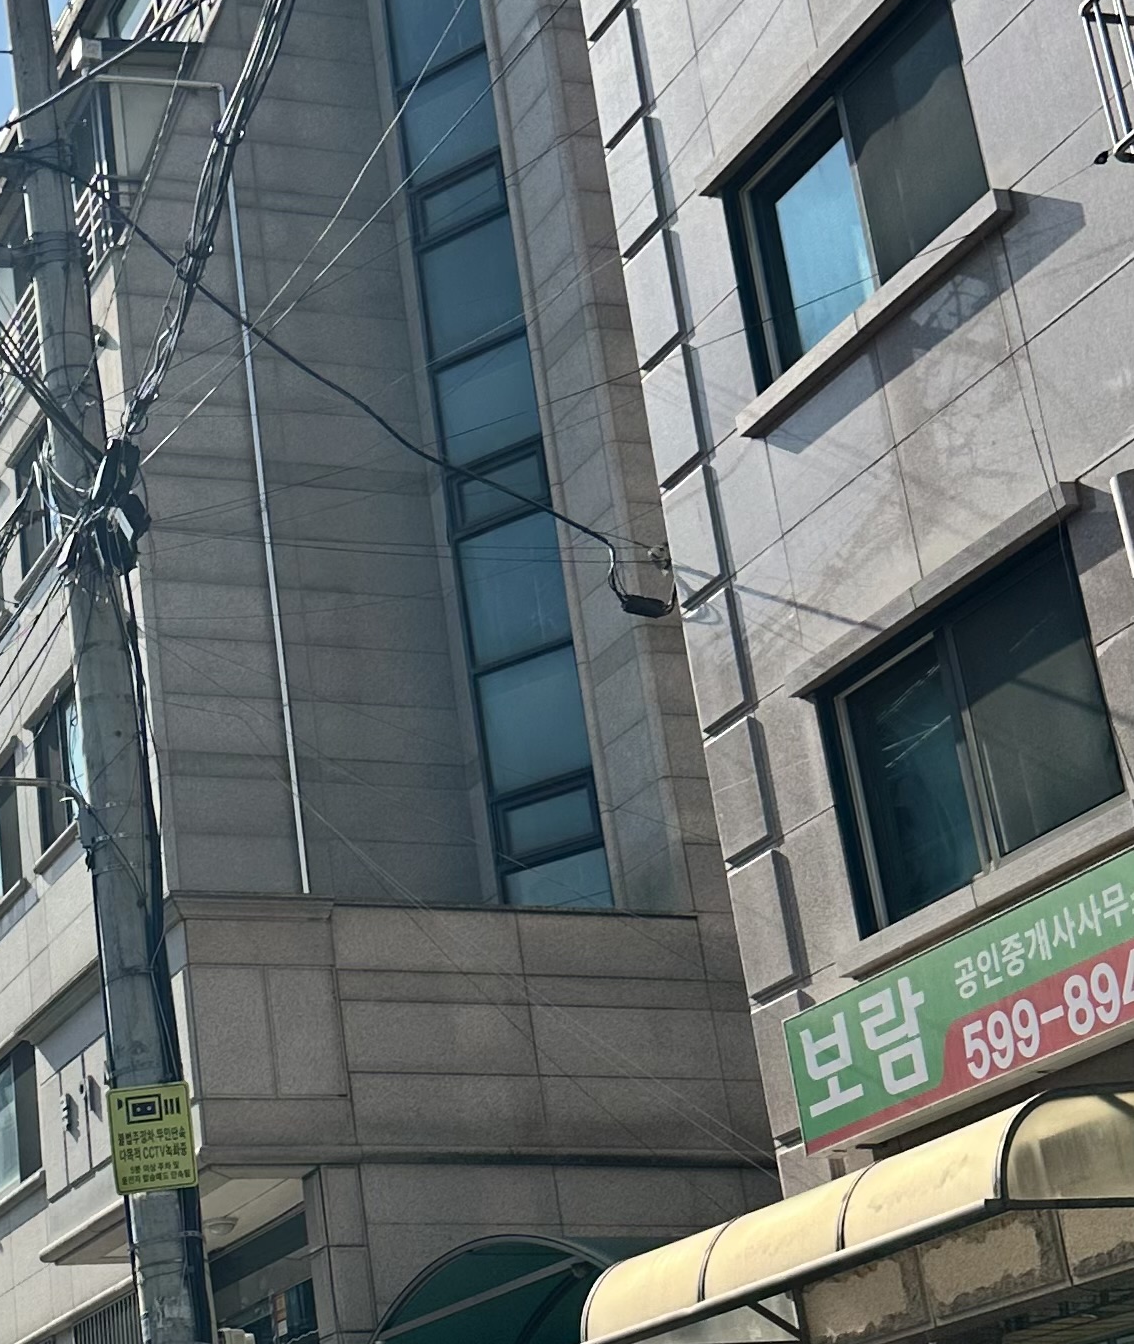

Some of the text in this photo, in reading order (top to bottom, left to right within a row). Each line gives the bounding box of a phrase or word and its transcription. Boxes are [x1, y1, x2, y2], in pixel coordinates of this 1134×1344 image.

[954, 882, 1134, 999] 공인중개사사무
[799, 976, 929, 1118] 보람
[118, 1126, 186, 1146] 불법주정차 무인단속
[119, 1147, 141, 1162] 다목적
[157, 1161, 171, 1171] 주차
